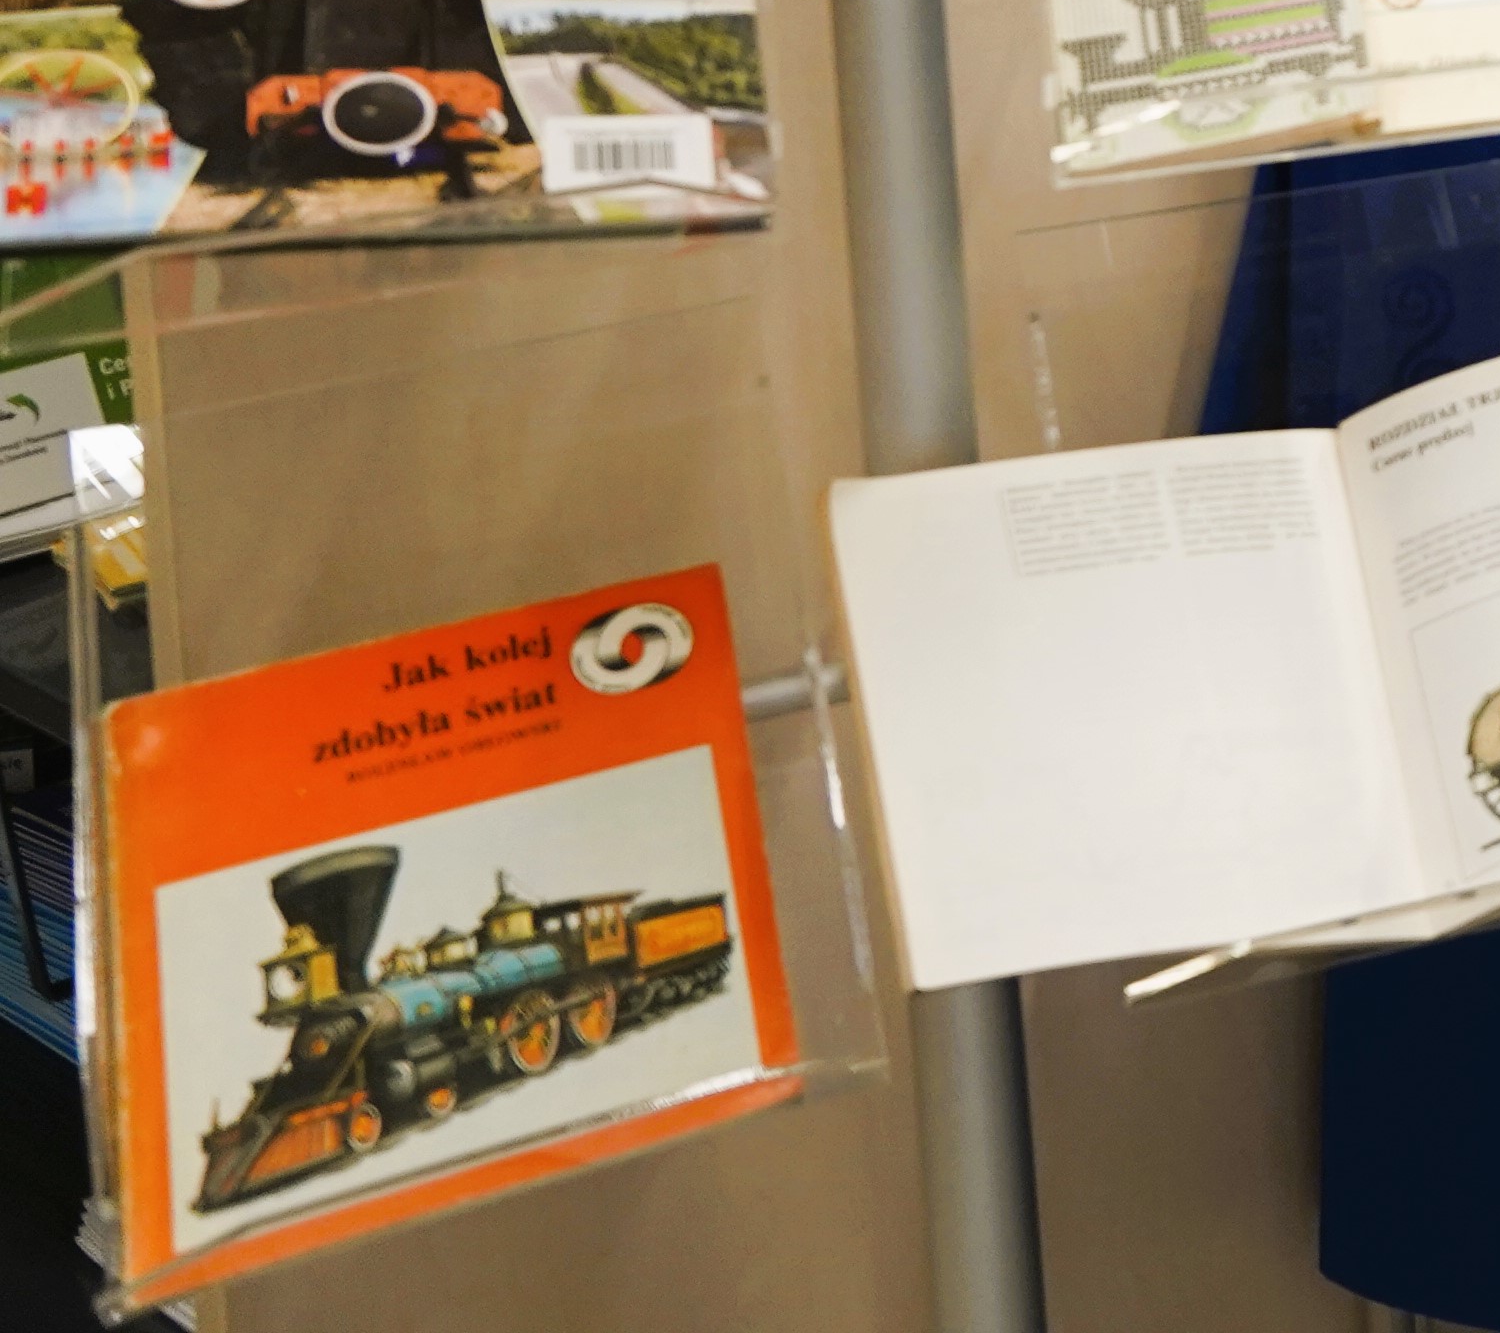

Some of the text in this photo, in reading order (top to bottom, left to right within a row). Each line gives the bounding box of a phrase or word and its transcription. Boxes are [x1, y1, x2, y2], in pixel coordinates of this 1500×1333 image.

[382, 626, 554, 693] Jak kolej
[313, 711, 451, 764] zdobyła
[465, 682, 558, 720] świat
